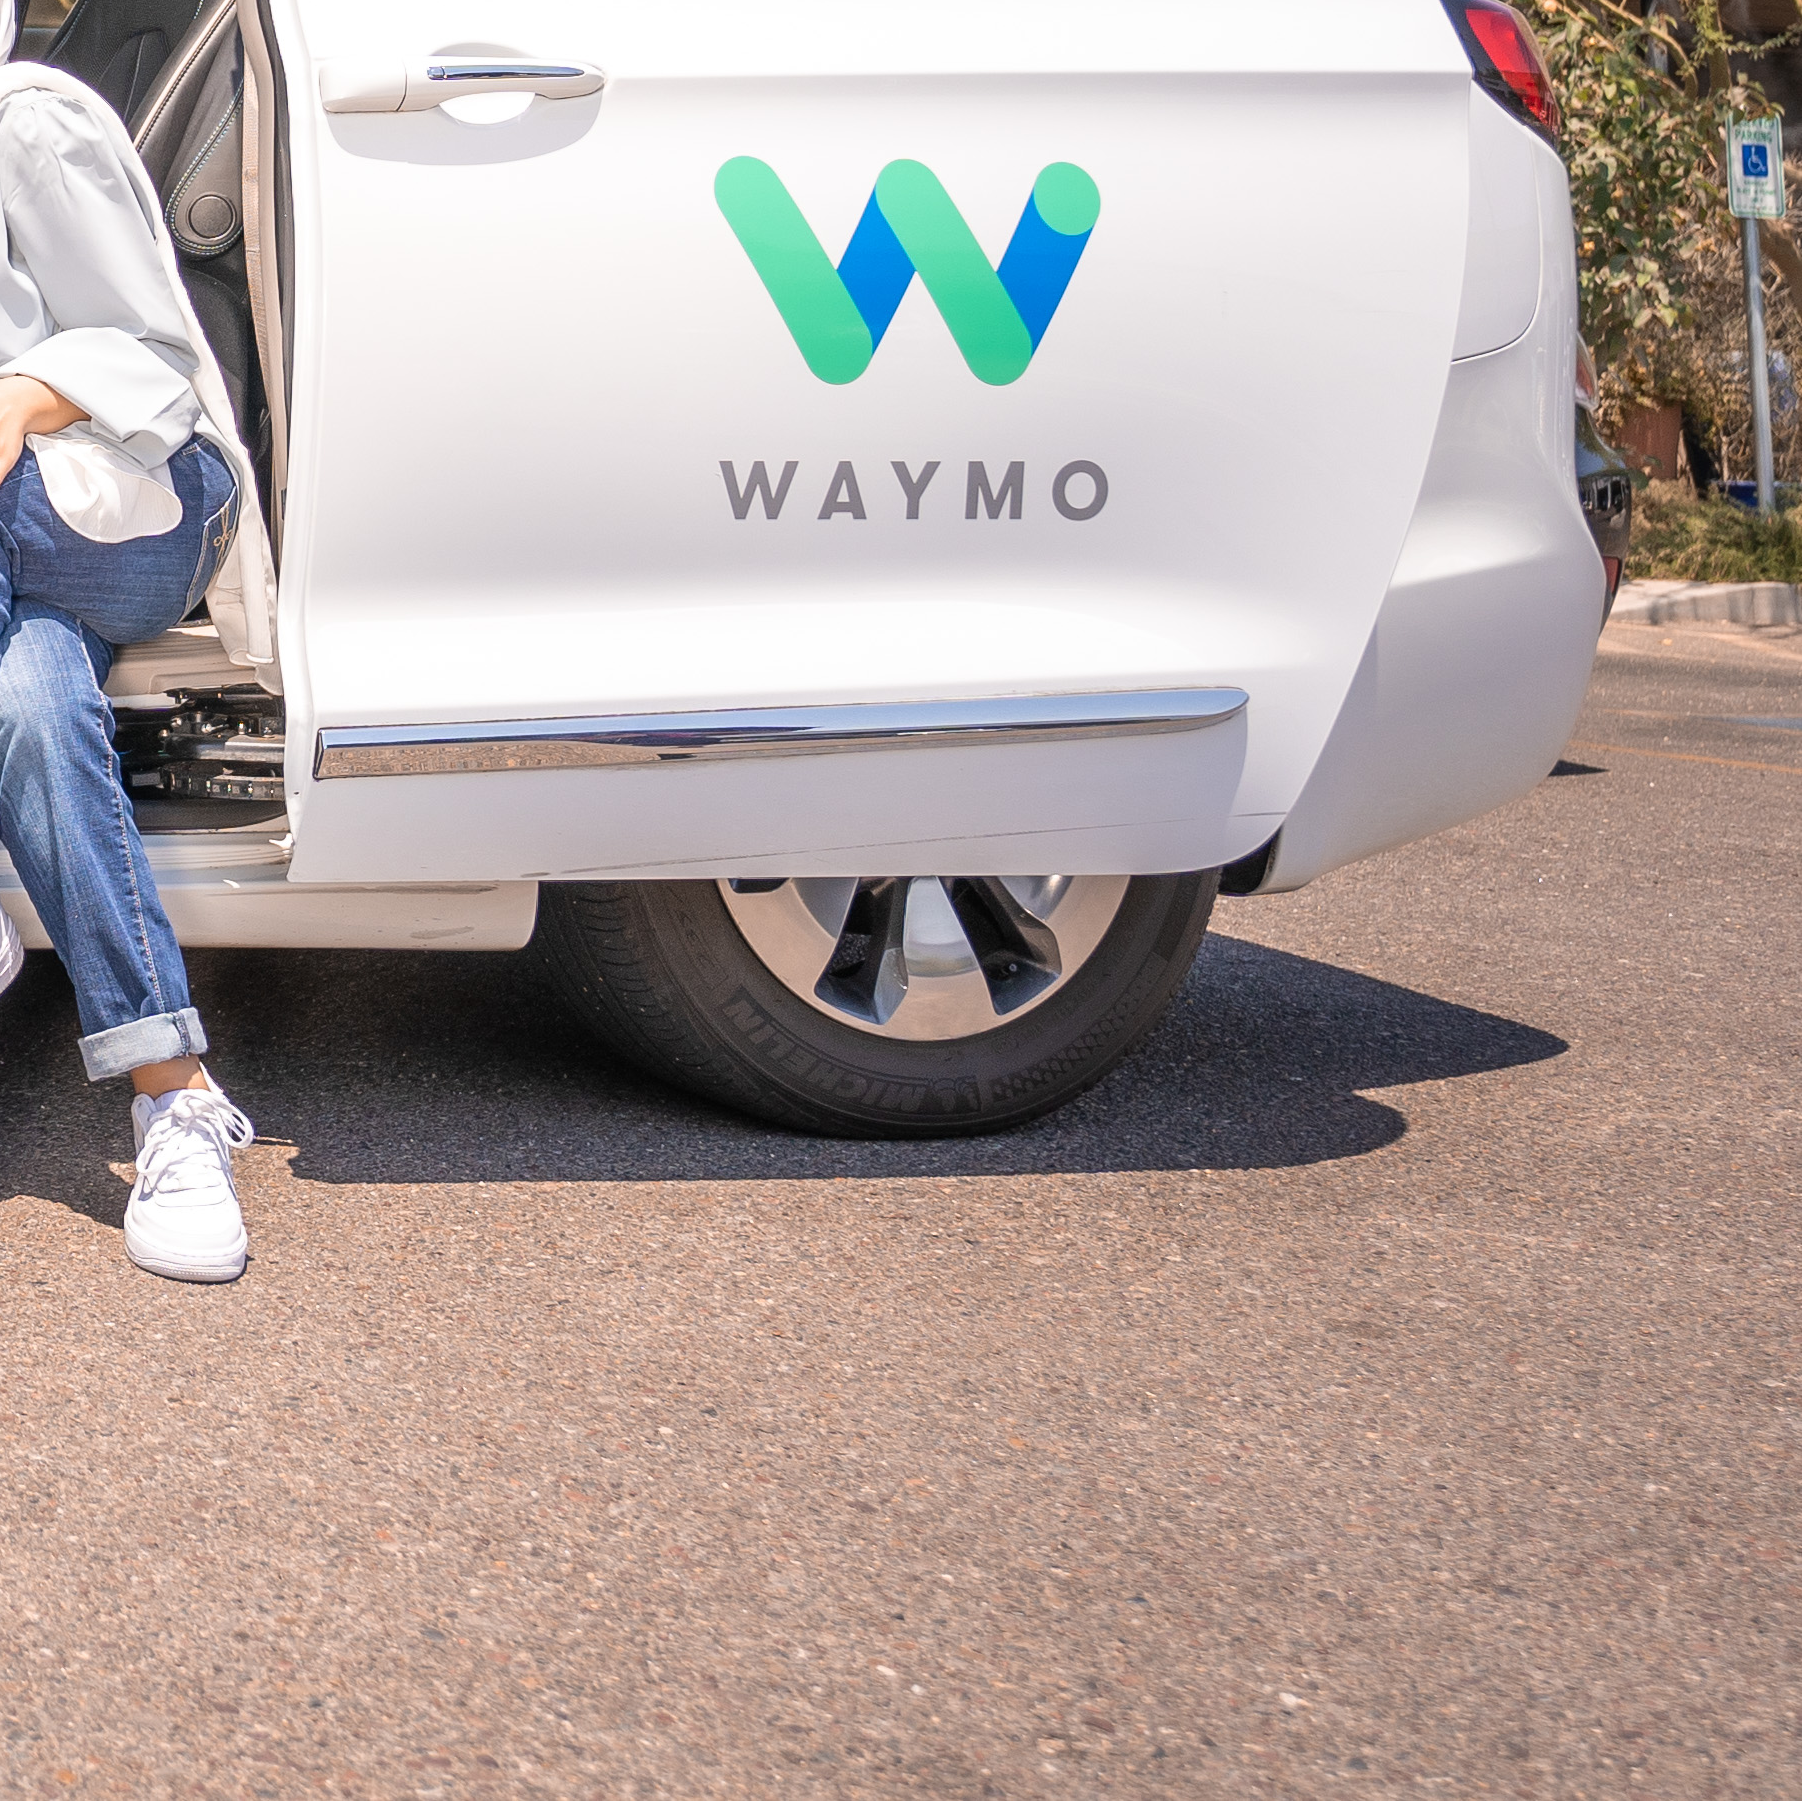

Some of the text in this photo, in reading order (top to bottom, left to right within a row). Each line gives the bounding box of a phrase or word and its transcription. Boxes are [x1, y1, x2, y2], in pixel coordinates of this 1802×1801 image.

[1735, 129, 1773, 142] PARKING
[719, 459, 1109, 521] WAYMO
[722, 999, 924, 1111] MICHELIN
